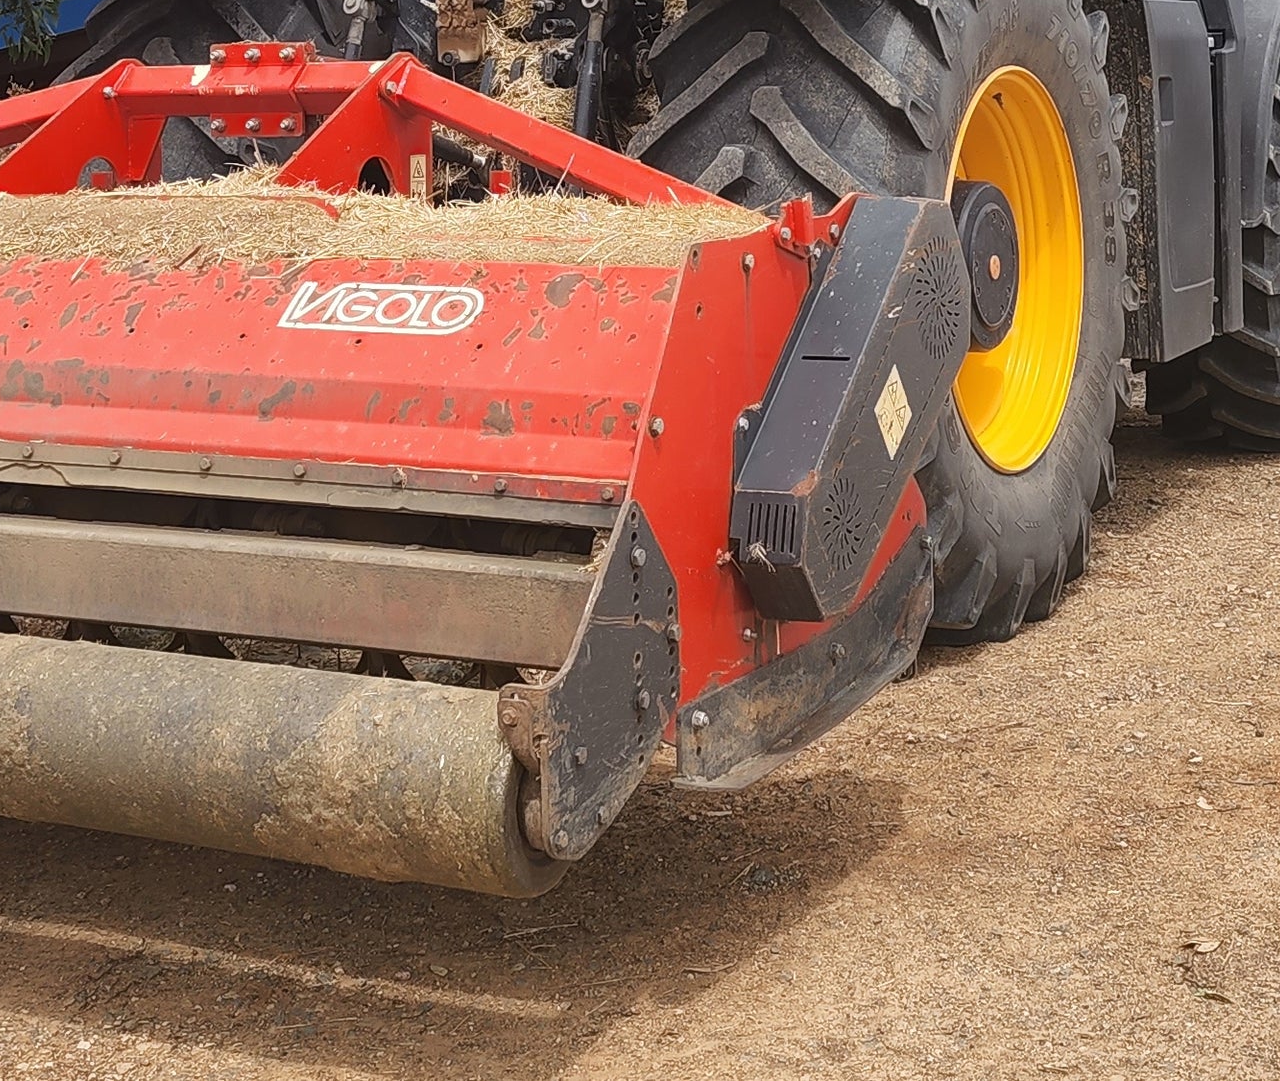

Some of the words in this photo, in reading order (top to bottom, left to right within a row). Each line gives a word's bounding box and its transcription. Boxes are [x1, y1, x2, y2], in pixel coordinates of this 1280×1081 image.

[1095, 151, 1111, 186] R
[1103, 199, 1117, 268] 38
[279, 281, 481, 333] VIGOLO
